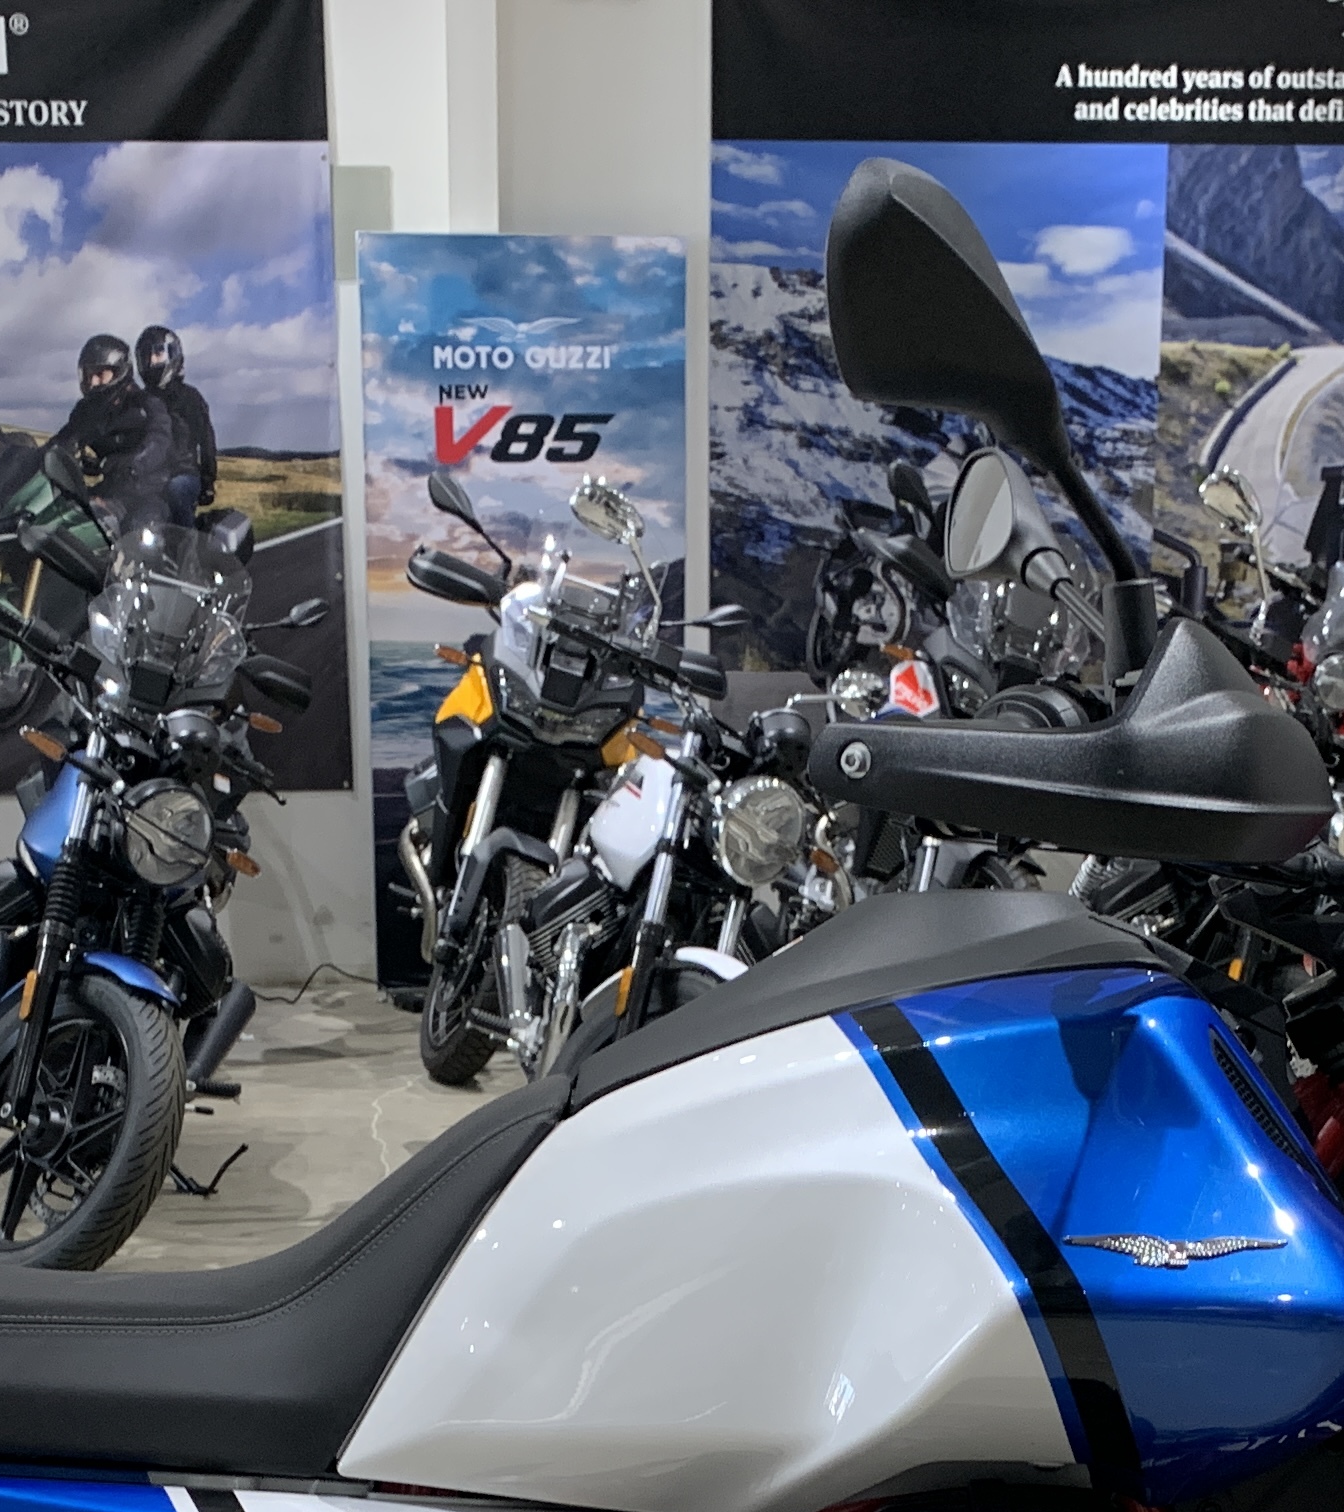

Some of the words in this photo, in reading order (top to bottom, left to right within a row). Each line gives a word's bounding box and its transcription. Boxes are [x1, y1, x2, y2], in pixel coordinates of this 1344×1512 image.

[1055, 63, 1073, 88] A
[1077, 63, 1178, 89] hundred
[1182, 68, 1244, 94] years
[1248, 65, 1275, 90] of
[1074, 96, 1120, 122] and
[1123, 95, 1244, 123] celebrities
[1248, 98, 1295, 123] that
[433, 345, 514, 370] MOTO
[439, 384, 489, 402] NEW
[434, 405, 616, 464] V85
